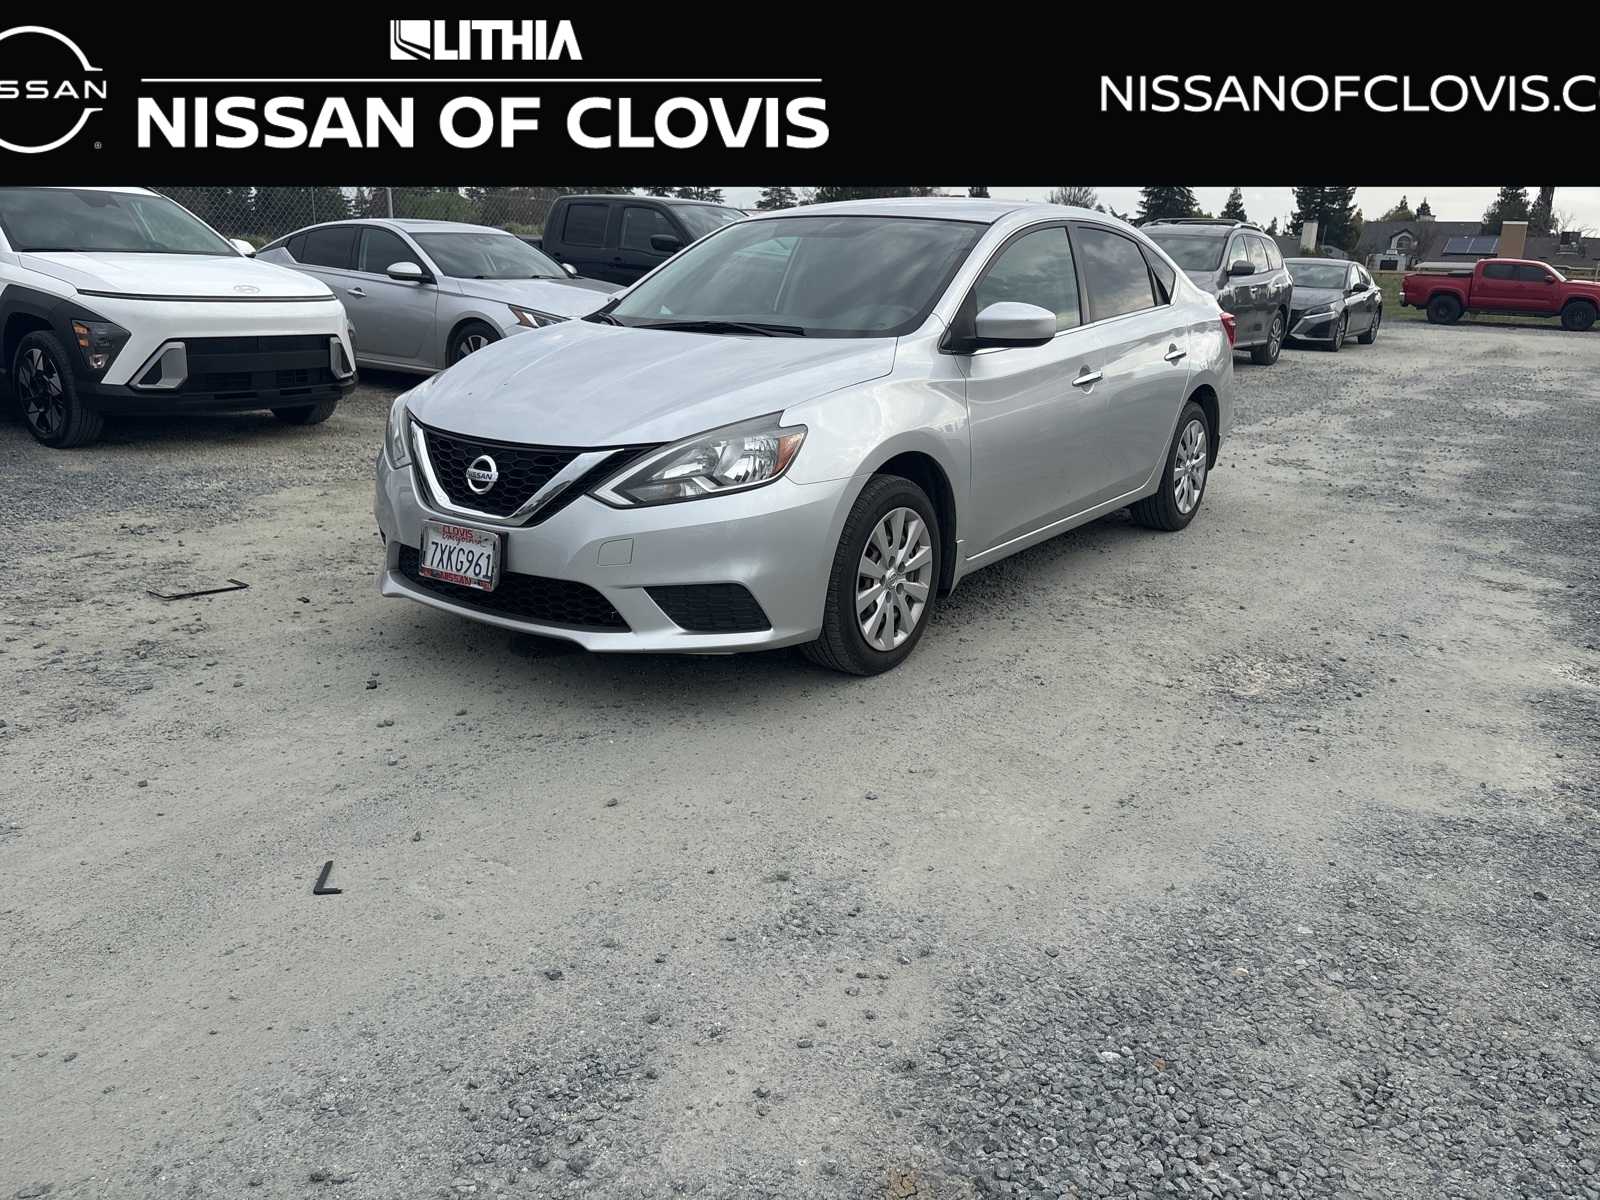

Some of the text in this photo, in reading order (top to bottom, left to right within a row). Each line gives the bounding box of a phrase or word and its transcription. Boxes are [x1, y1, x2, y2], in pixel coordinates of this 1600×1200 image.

[467, 470, 493, 480] NISSAN
[442, 525, 473, 538] CLOVIS
[431, 541, 494, 579] 7XKG961
